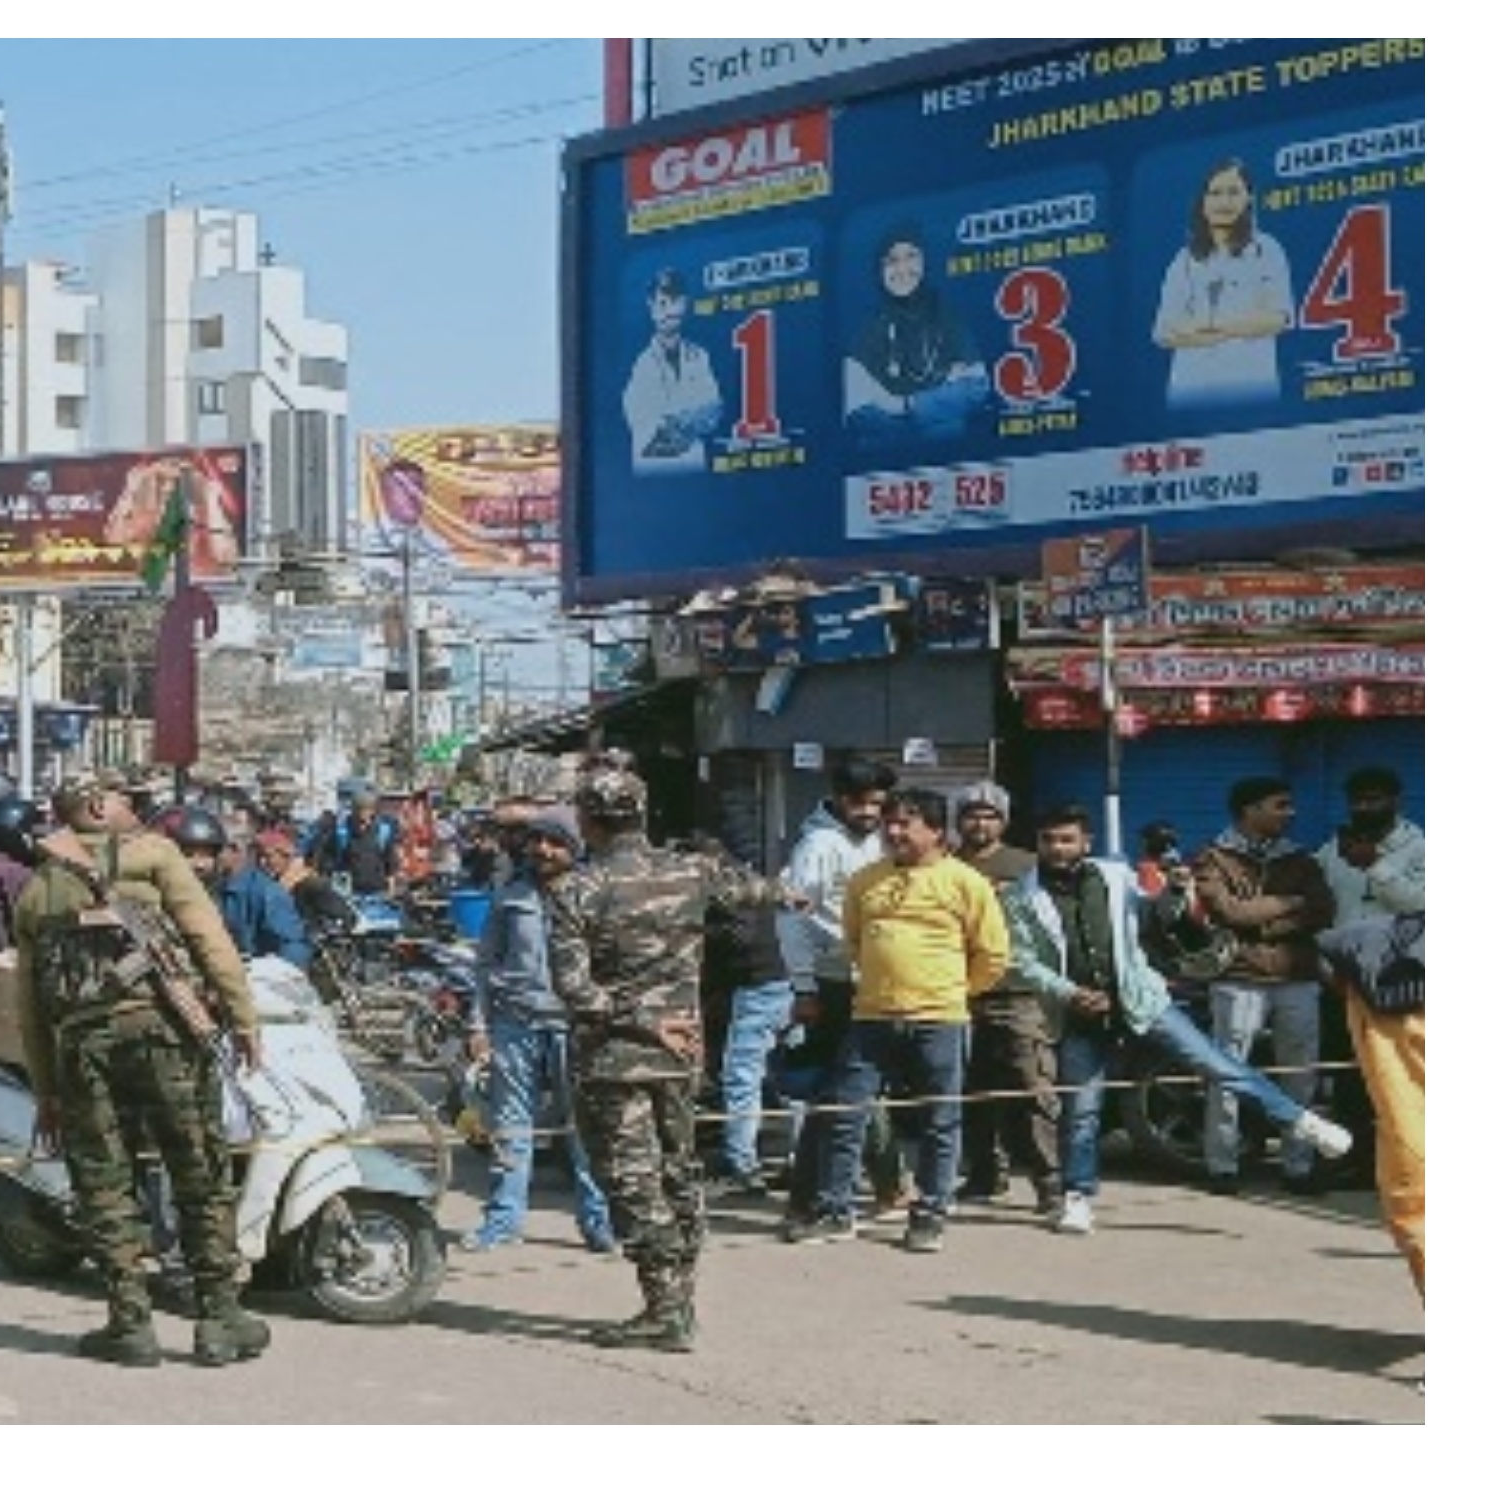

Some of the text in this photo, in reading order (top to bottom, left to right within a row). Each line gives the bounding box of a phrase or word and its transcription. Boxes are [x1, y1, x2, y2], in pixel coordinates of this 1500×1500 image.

[651, 123, 801, 191] GOAL
[987, 38, 1424, 149] JHARKHAND STATE TOPPERS
[994, 267, 1077, 403] 3
[1300, 202, 1407, 362] 4
[732, 309, 781, 440] 1
